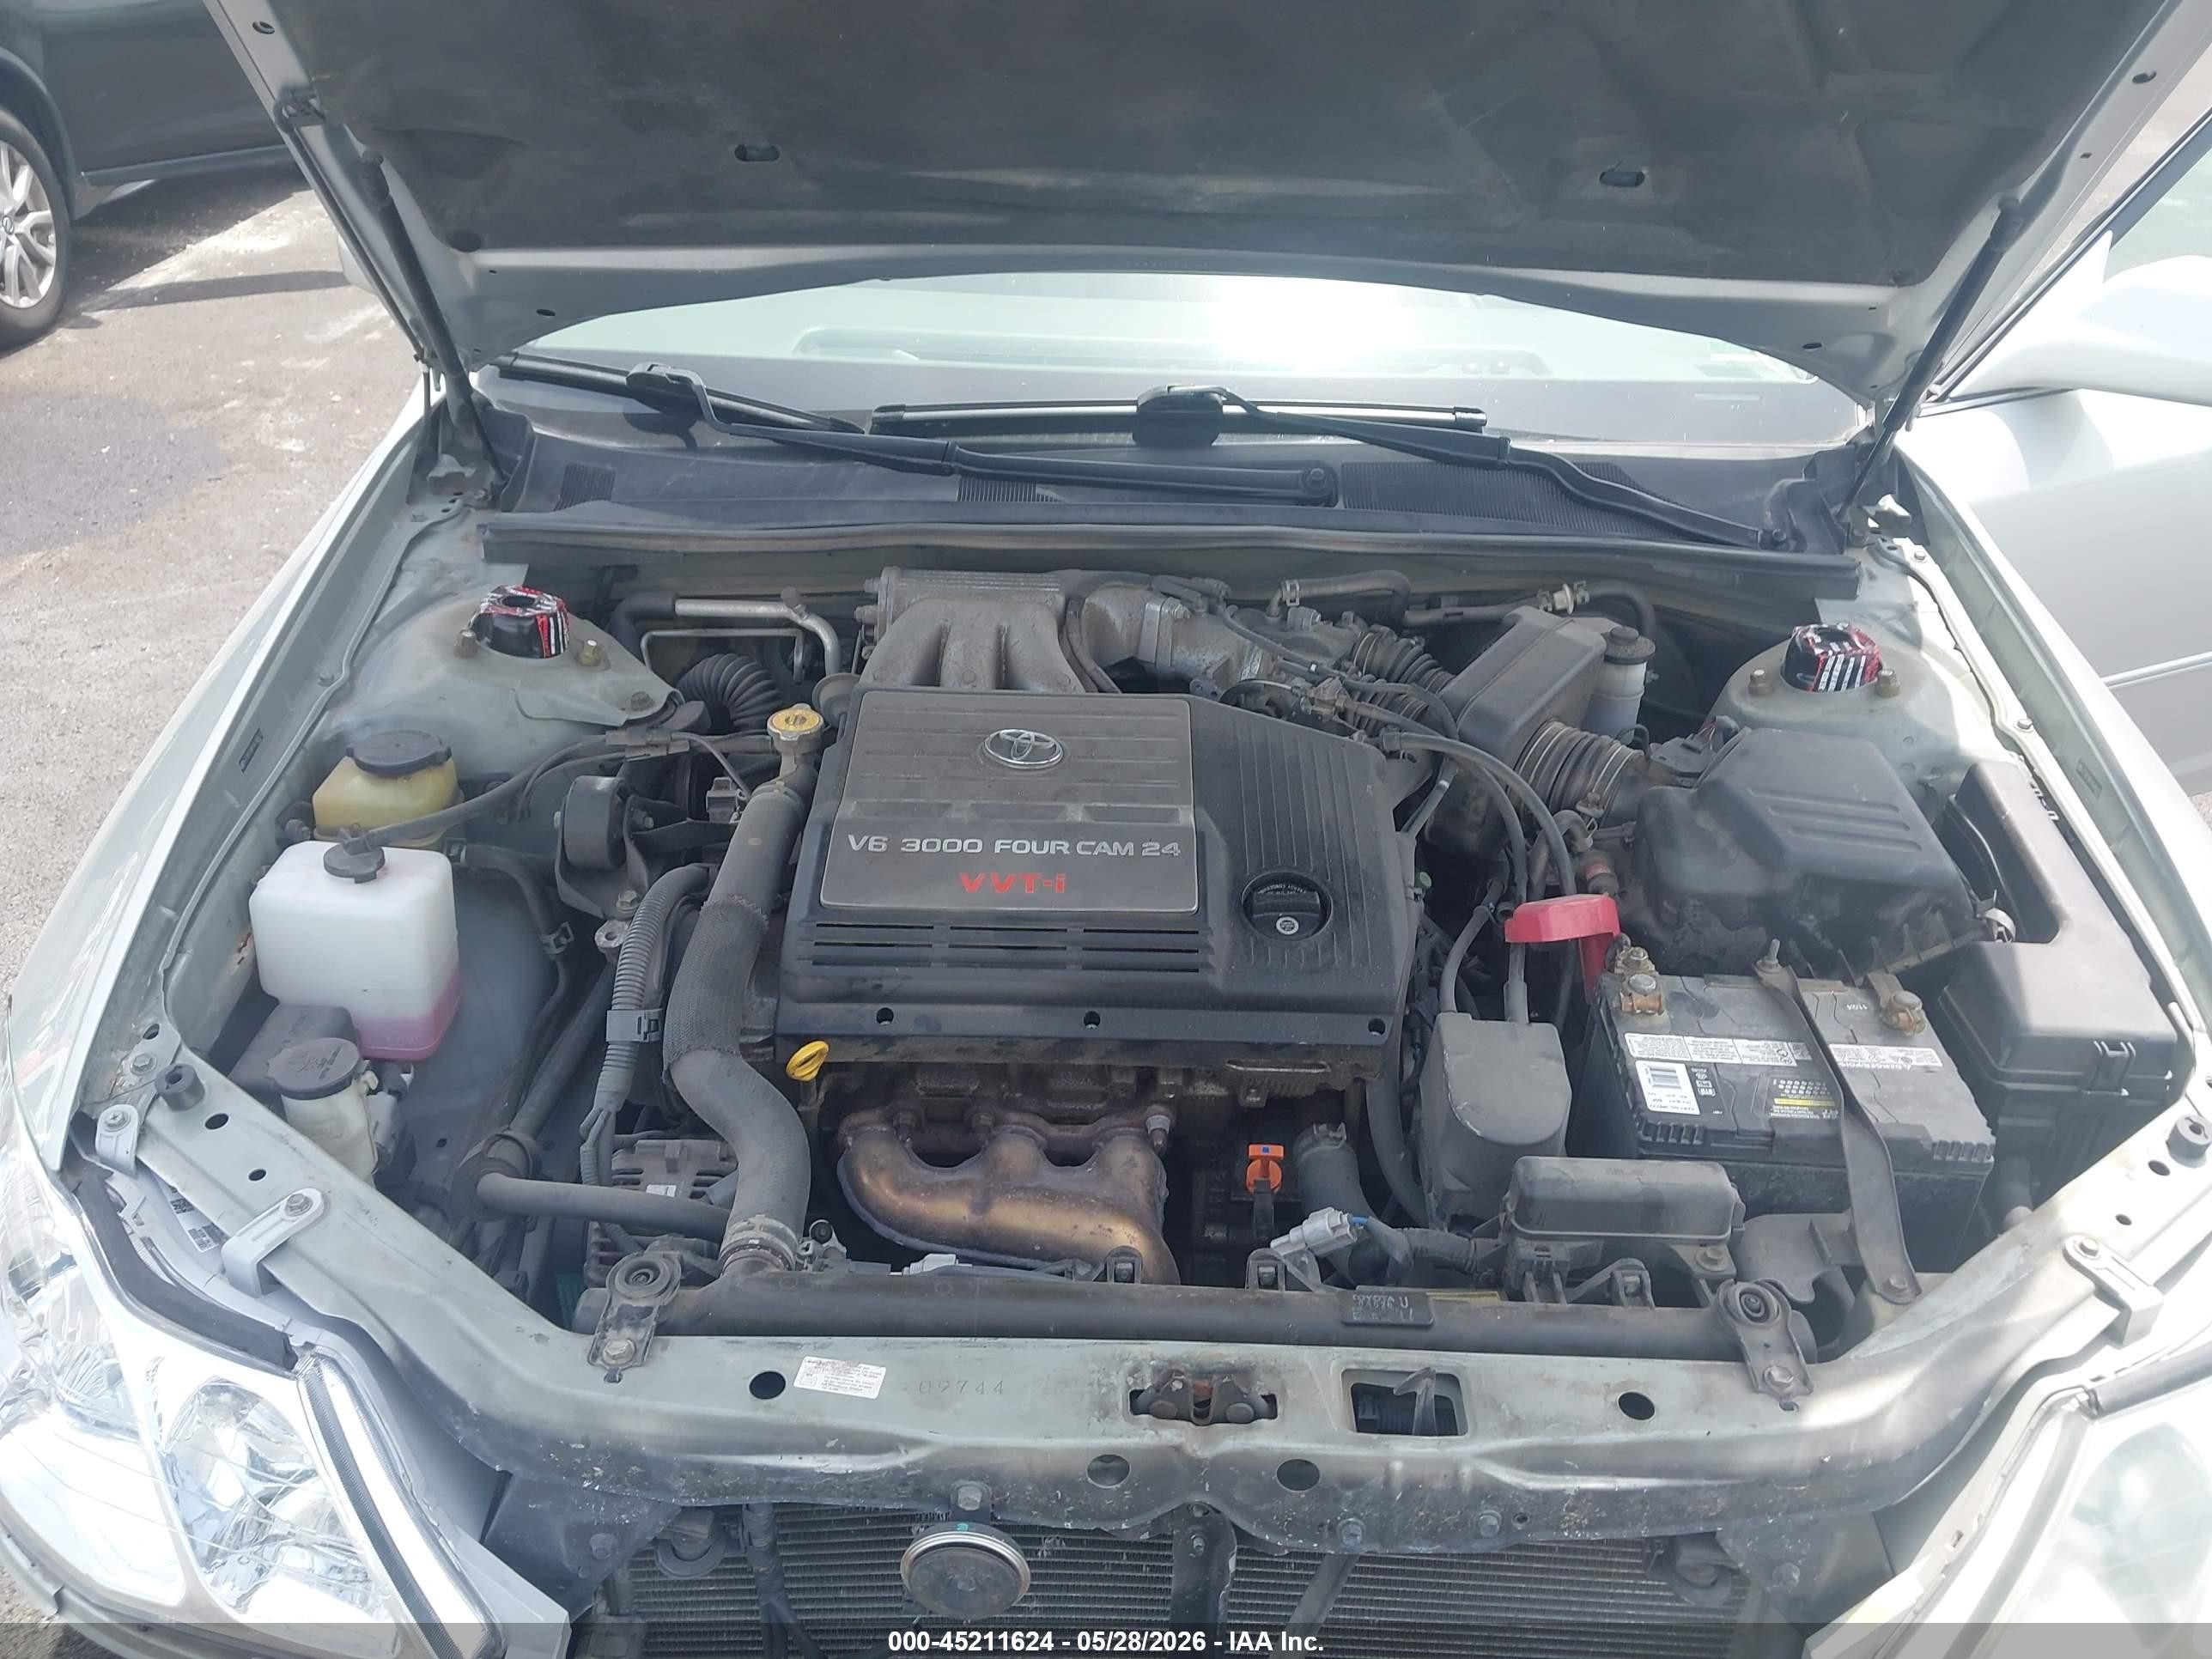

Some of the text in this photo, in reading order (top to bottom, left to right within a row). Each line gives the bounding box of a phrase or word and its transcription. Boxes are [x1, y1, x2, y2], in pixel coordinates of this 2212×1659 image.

[848, 834, 1182, 857] V6 3000 FOUR CAM 24
[959, 872, 1066, 894] VVT-i
[918, 1379, 1004, 1395] 09744
